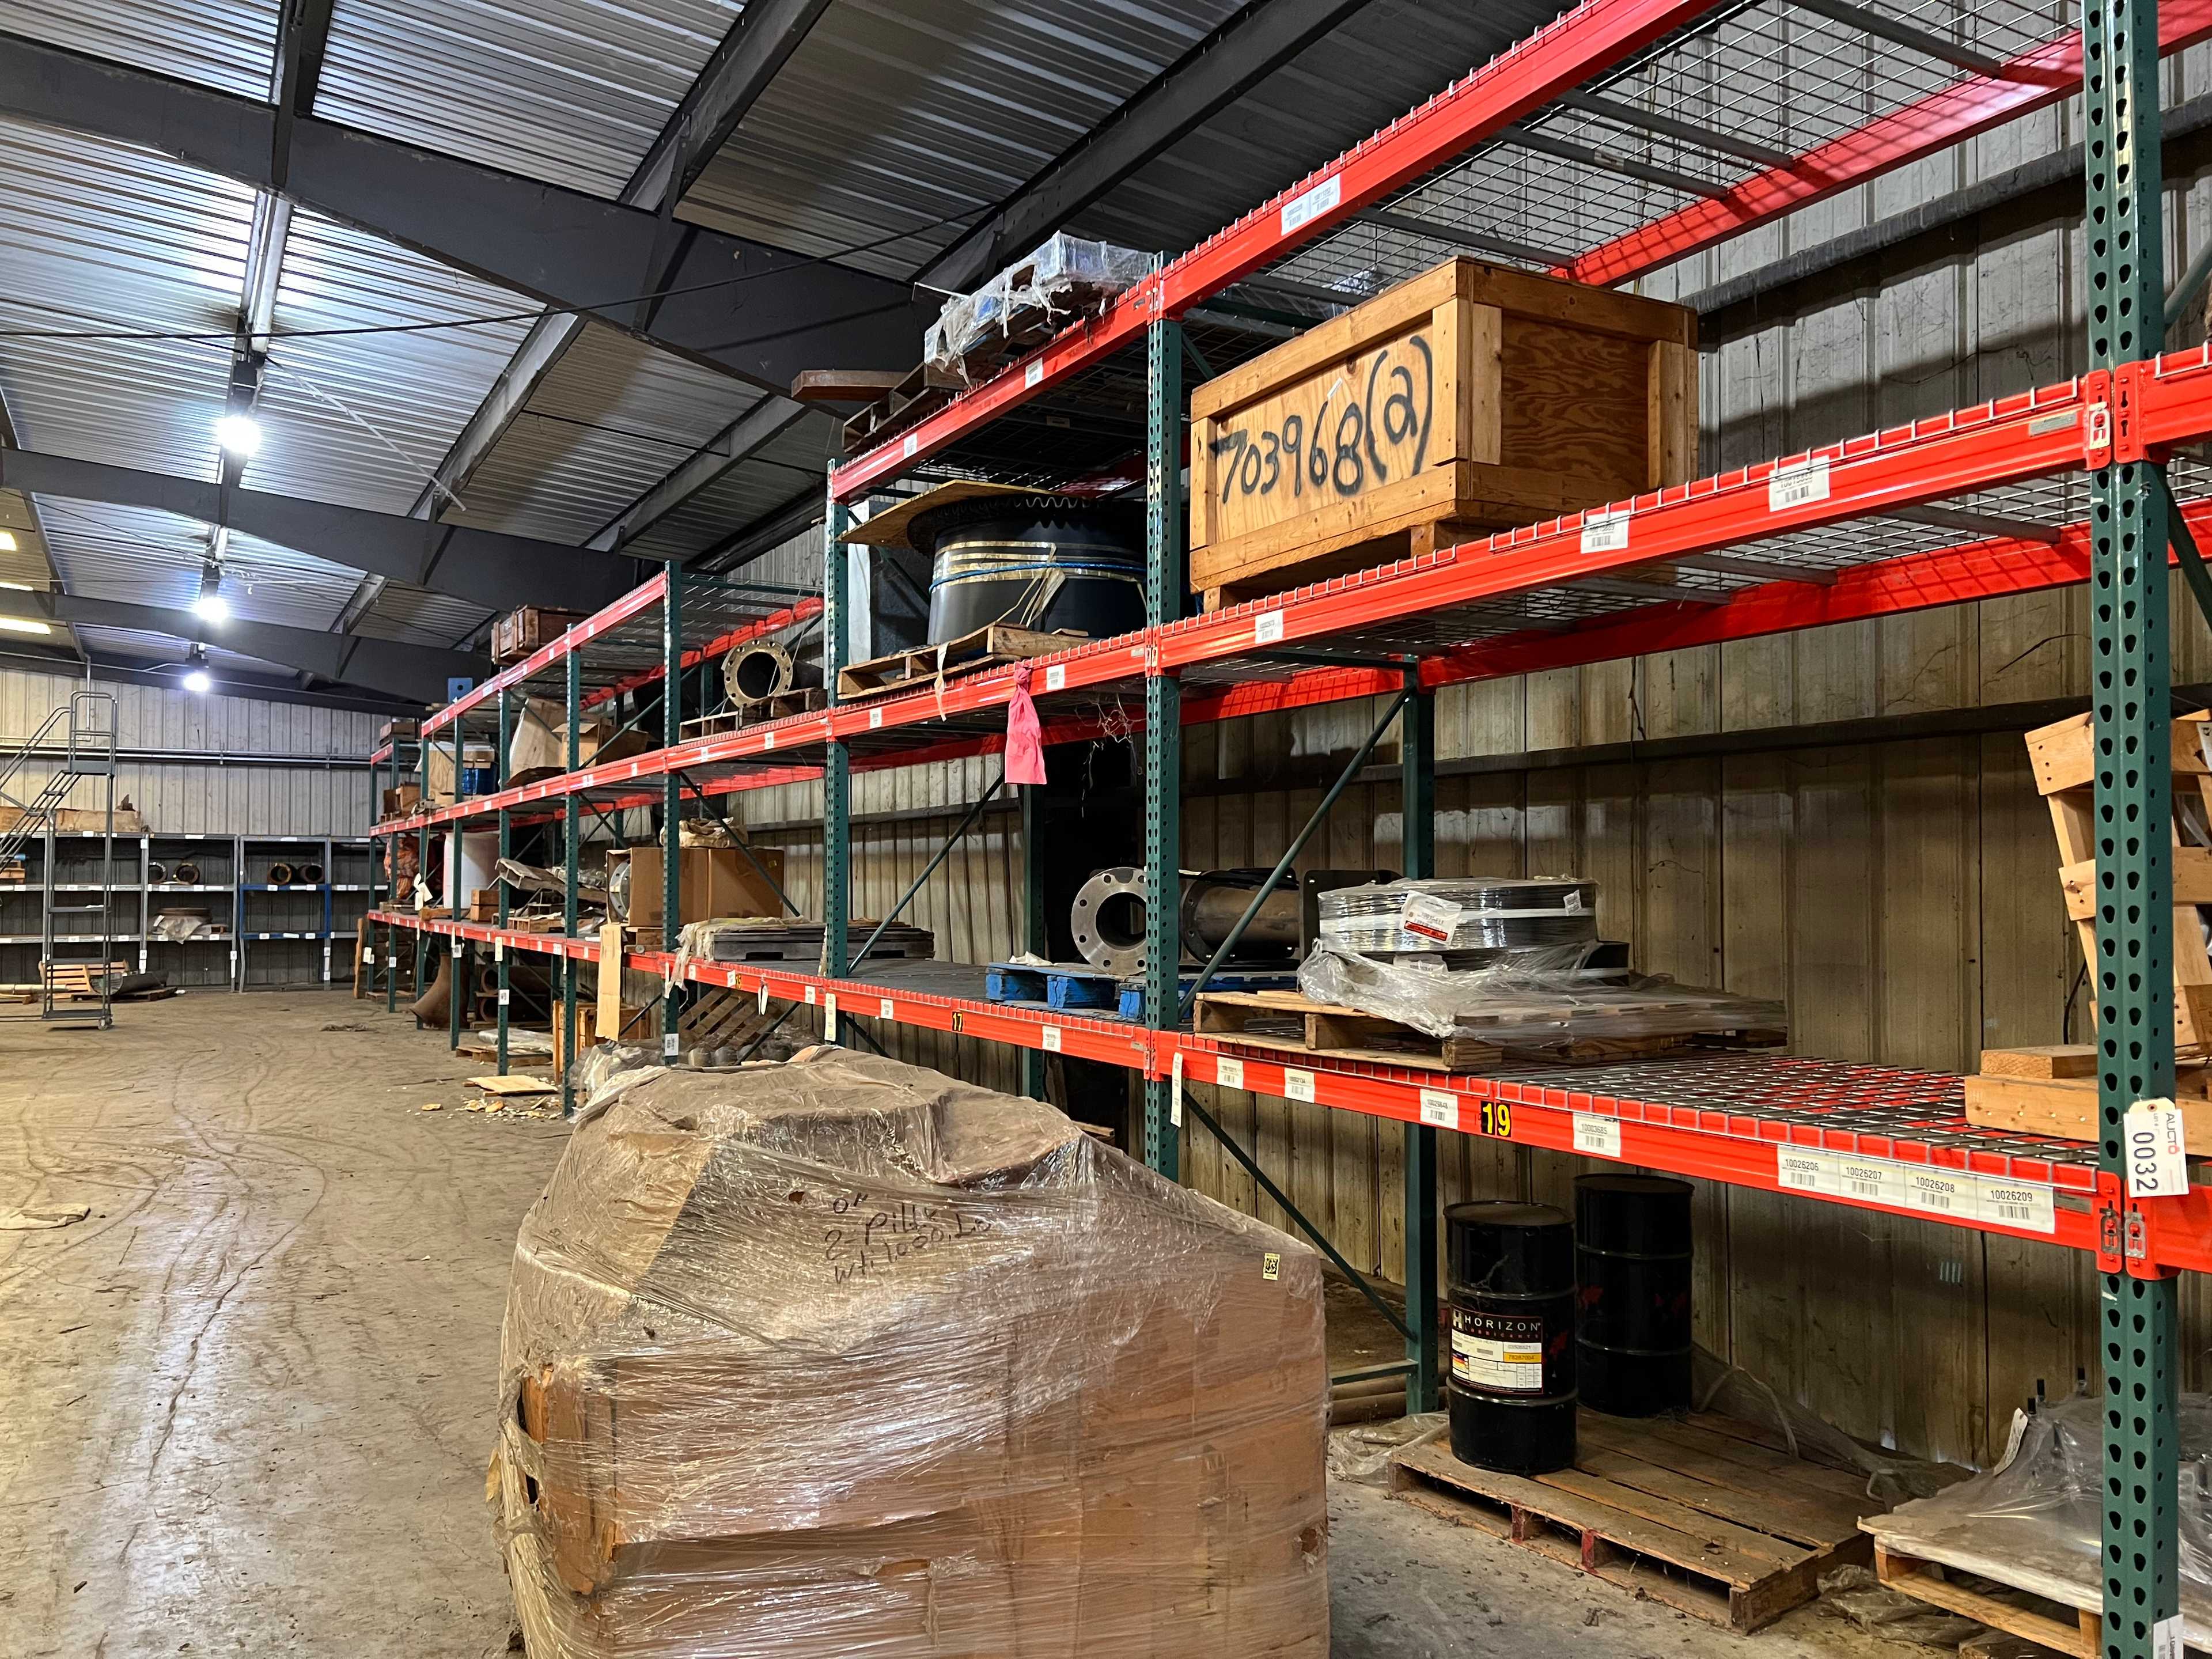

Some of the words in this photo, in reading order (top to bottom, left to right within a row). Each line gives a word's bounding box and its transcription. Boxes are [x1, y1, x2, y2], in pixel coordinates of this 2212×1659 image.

[952, 1012, 963, 1032] 17
[1482, 1103, 1510, 1137] 19
[2165, 1112, 2180, 1155] AUCTO
[1785, 1159, 1819, 1171] 10026206
[2133, 1131, 2159, 1192] 0032
[1846, 1166, 1882, 1180] 10026207
[1915, 1176, 1955, 1193] 10026208
[1991, 1190, 2033, 1202] 10026209
[1464, 1315, 1539, 1331] HORIZON
